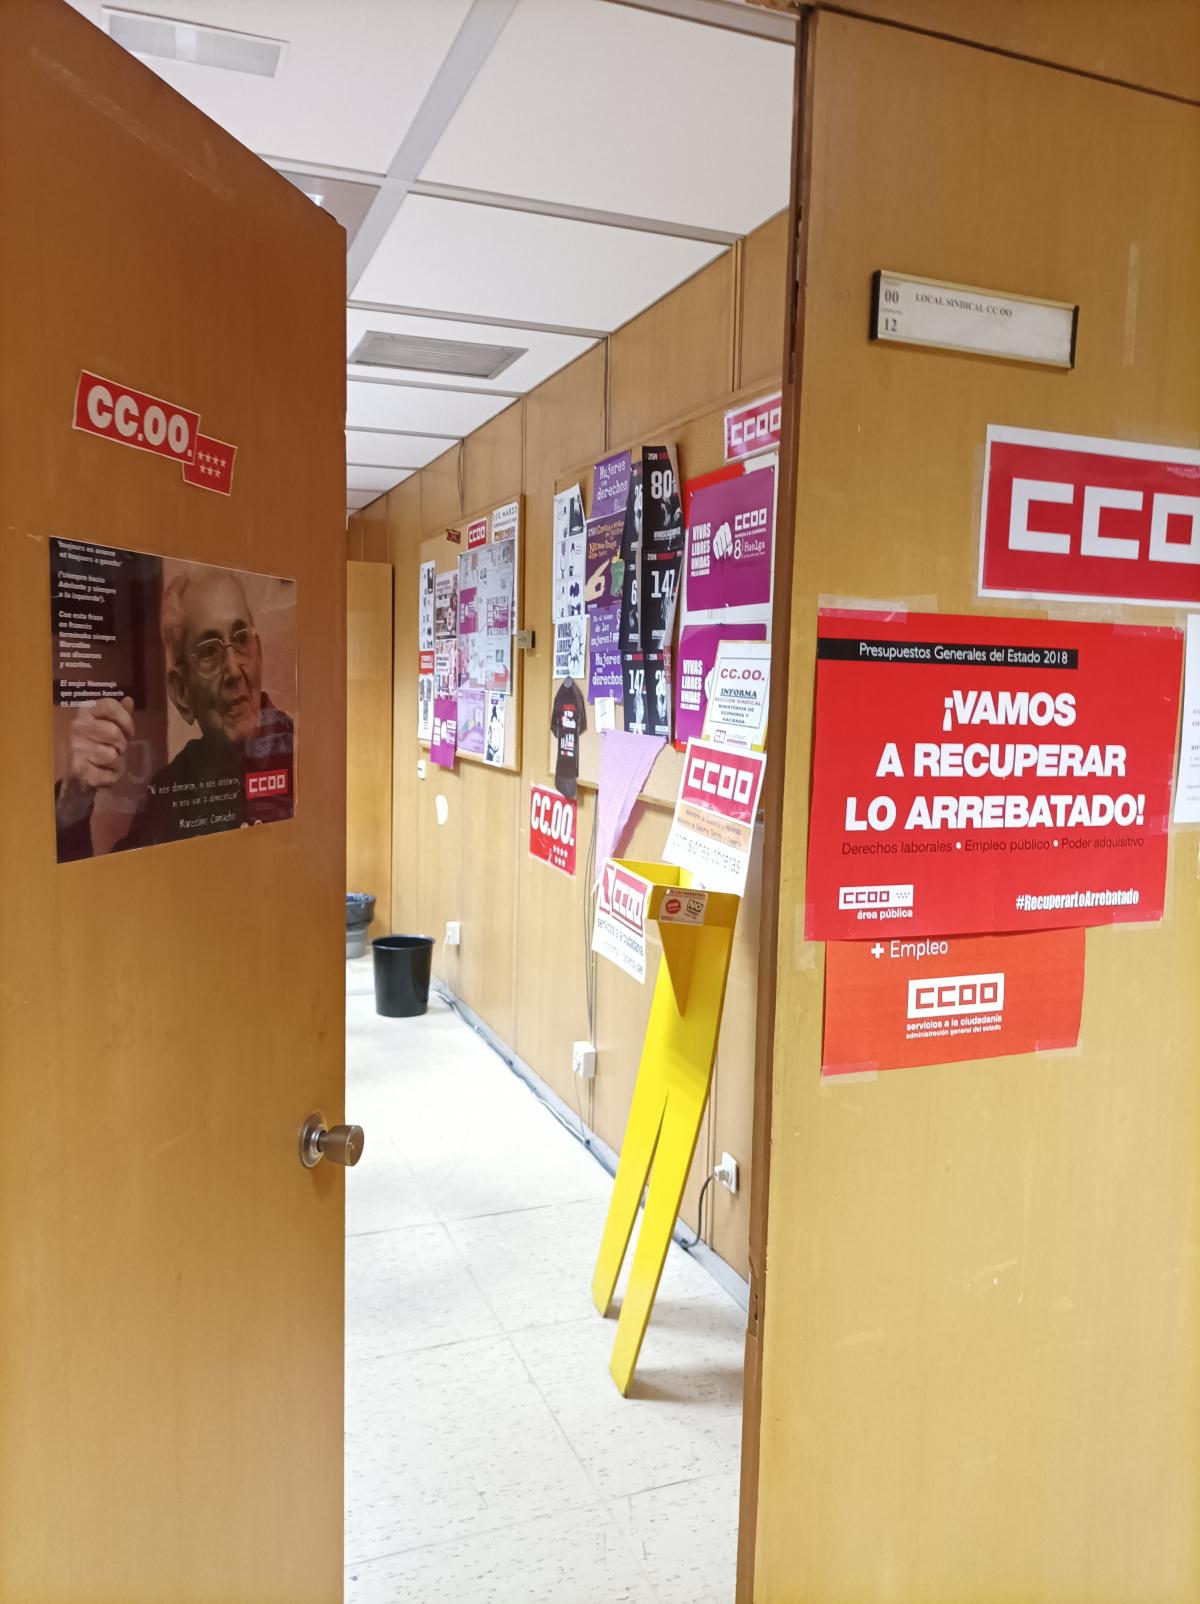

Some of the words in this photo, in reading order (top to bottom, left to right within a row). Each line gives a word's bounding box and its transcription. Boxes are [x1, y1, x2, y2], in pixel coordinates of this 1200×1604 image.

[884, 289, 899, 305] 00
[915, 293, 944, 306] LOCAL
[945, 299, 985, 313] SINDICAL
[884, 317, 897, 333] 12
[87, 385, 192, 457] CC.OO.
[731, 407, 781, 446] CCOO
[600, 461, 626, 480] Mujeres
[597, 480, 628, 501] derechos
[651, 469, 672, 499] 80
[735, 508, 767, 531] CCOO
[469, 525, 486, 543] CCOO
[692, 522, 711, 541] VIVAS
[691, 539, 710, 557] LIBRES
[734, 539, 741, 559] 8
[744, 540, 765, 553] Huelga
[651, 569, 675, 598] 147
[58, 610, 72, 618] Con
[595, 650, 620, 669] Mujeres
[859, 642, 931, 660] Presupuestos
[934, 645, 986, 662] Generales
[989, 648, 1005, 662] del
[1008, 649, 1041, 664] Estado
[1043, 650, 1068, 665] 2018
[683, 659, 703, 675] VIVAS
[720, 668, 765, 681] CC.OO.
[592, 672, 623, 685] derechos
[629, 670, 645, 694] 147
[682, 675, 702, 690] LIBRES
[60, 690, 73, 698] que
[720, 688, 757, 699] INFORMA
[942, 690, 1076, 731] ¡VAMOS
[876, 743, 904, 777] A
[914, 743, 1126, 778] RECUPERAR
[249, 774, 286, 793] CCOO
[688, 757, 753, 804] CCOO
[531, 791, 574, 848] CC.OO.
[844, 796, 896, 831] LO
[904, 794, 1145, 830] ARREBATADO!
[842, 841, 898, 855] Derechos
[900, 839, 952, 853] laborales
[964, 839, 1006, 855] Empleo
[1010, 837, 1050, 853] público
[1061, 837, 1092, 850] Poder
[1093, 836, 1144, 851] adquisitivo
[612, 883, 645, 924] CCOO
[688, 900, 702, 912] NO
[843, 890, 890, 904] CCOO
[1015, 889, 1139, 912] #RecuperarLoArrebatado
[857, 908, 878, 920] área
[880, 907, 913, 921] pública
[890, 940, 948, 960] Empleo
[915, 982, 998, 1010] CCOO
[905, 1029, 949, 1040] administración
[950, 1026, 971, 1037] general
[972, 1025, 981, 1033] del
[982, 1024, 1001, 1034] estado
[906, 1020, 941, 1031] servicios
[943, 1020, 950, 1028] a
[951, 1018, 958, 1027] la
[960, 1014, 1002, 1027] ciudadanía
